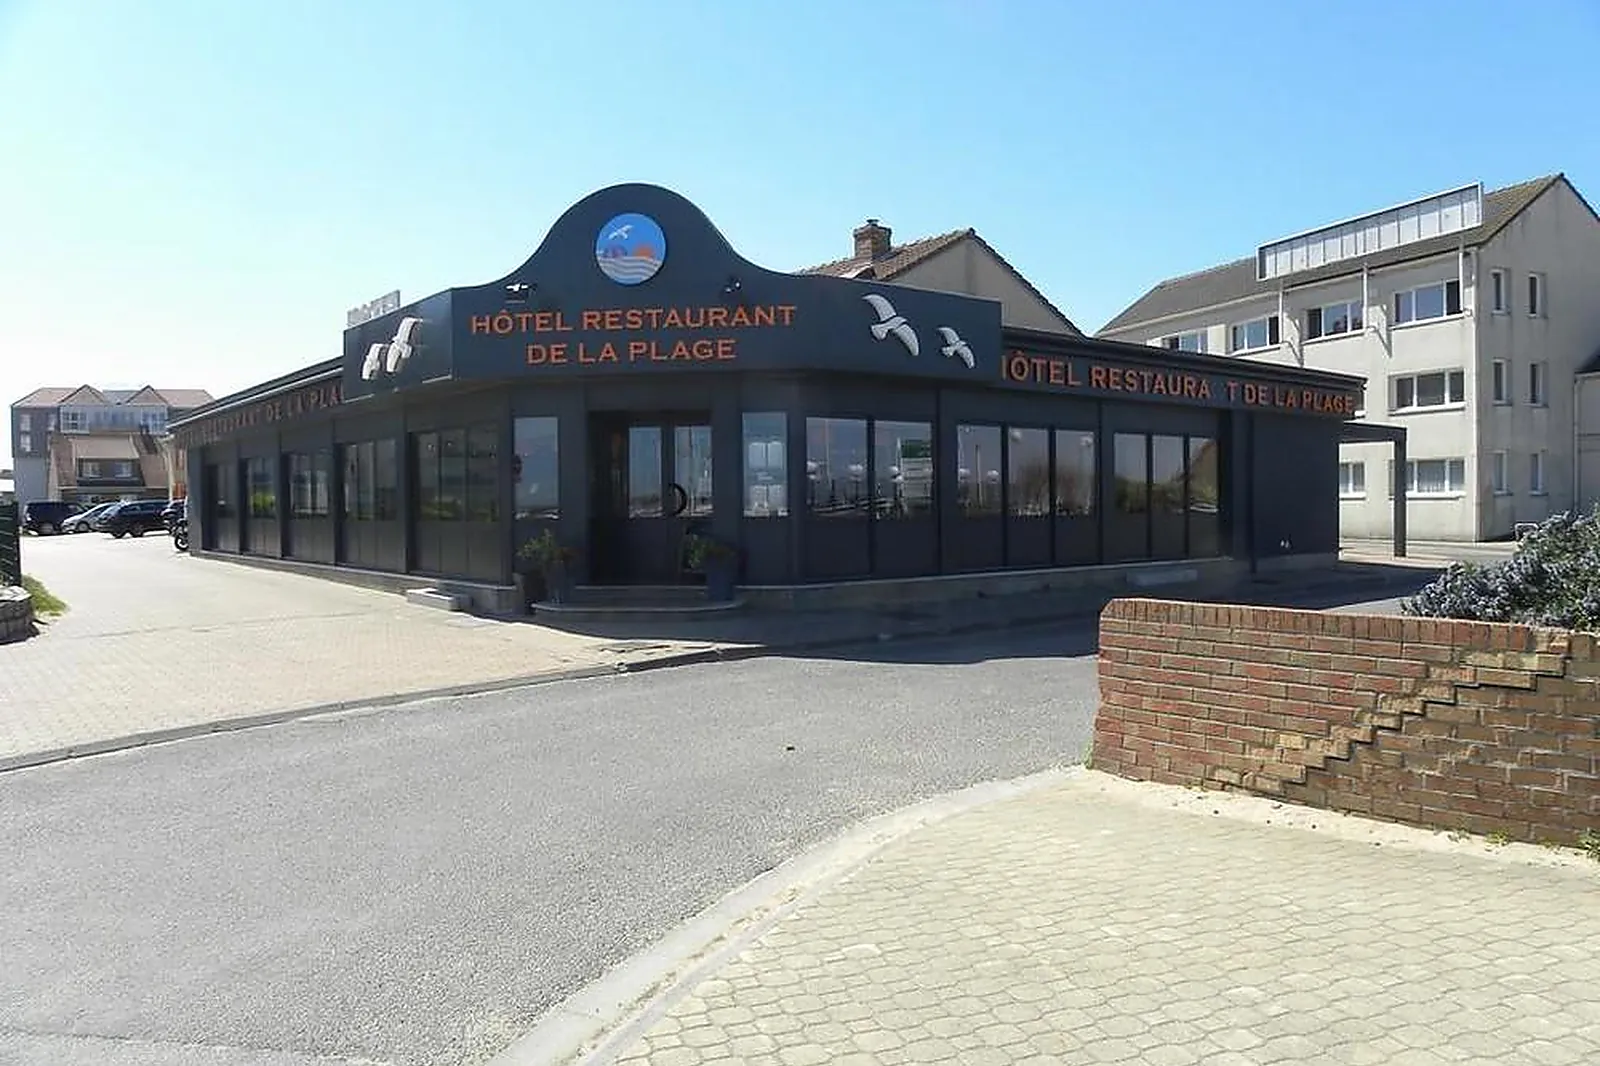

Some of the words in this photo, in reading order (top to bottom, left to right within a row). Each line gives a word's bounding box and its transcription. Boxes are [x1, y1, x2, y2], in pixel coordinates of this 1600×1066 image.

[471, 309, 573, 334] HÔTEL
[581, 304, 797, 331] RESTAURANT
[526, 343, 568, 365] DE
[578, 342, 619, 364] LA
[629, 338, 737, 362] PLAGE
[1001, 350, 1082, 387] ÔTEL
[1244, 382, 1270, 406] DE
[1274, 385, 1298, 408] LA
[1302, 389, 1354, 415] PLAGE
